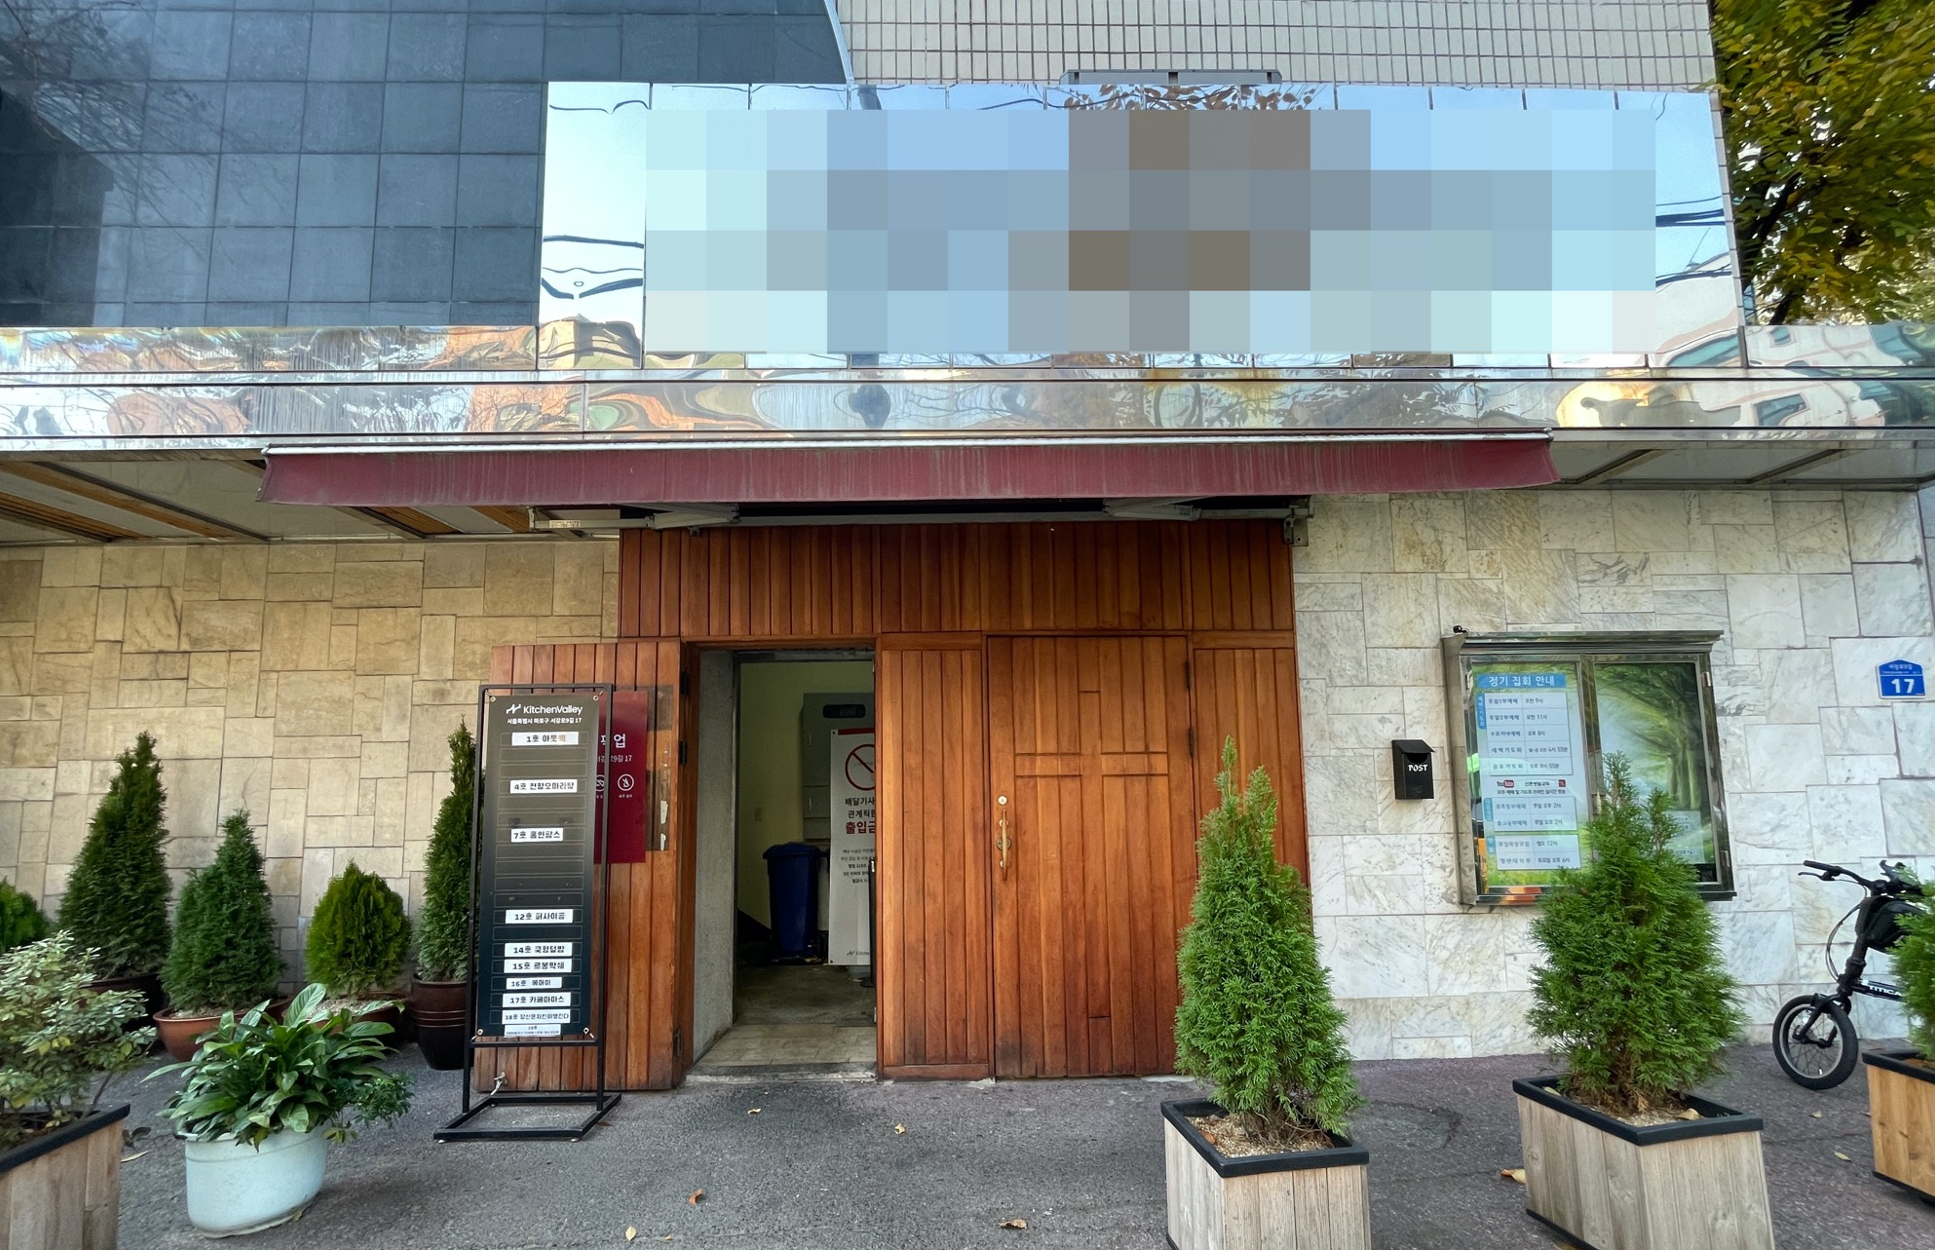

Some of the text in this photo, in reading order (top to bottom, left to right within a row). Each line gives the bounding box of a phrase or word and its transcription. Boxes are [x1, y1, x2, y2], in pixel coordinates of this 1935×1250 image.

[1489, 675, 1555, 687] 정기 집회 안내
[1891, 678, 1914, 693] 17
[523, 705, 583, 716] KitchenValley
[526, 734, 539, 743] 1호
[514, 783, 527, 791] 4호
[845, 821, 875, 835] 출입금
[514, 831, 526, 839] 7호
[515, 912, 532, 921] 12호
[513, 946, 532, 954] 14호
[513, 962, 531, 970] 15호
[510, 996, 527, 1004] 17호
